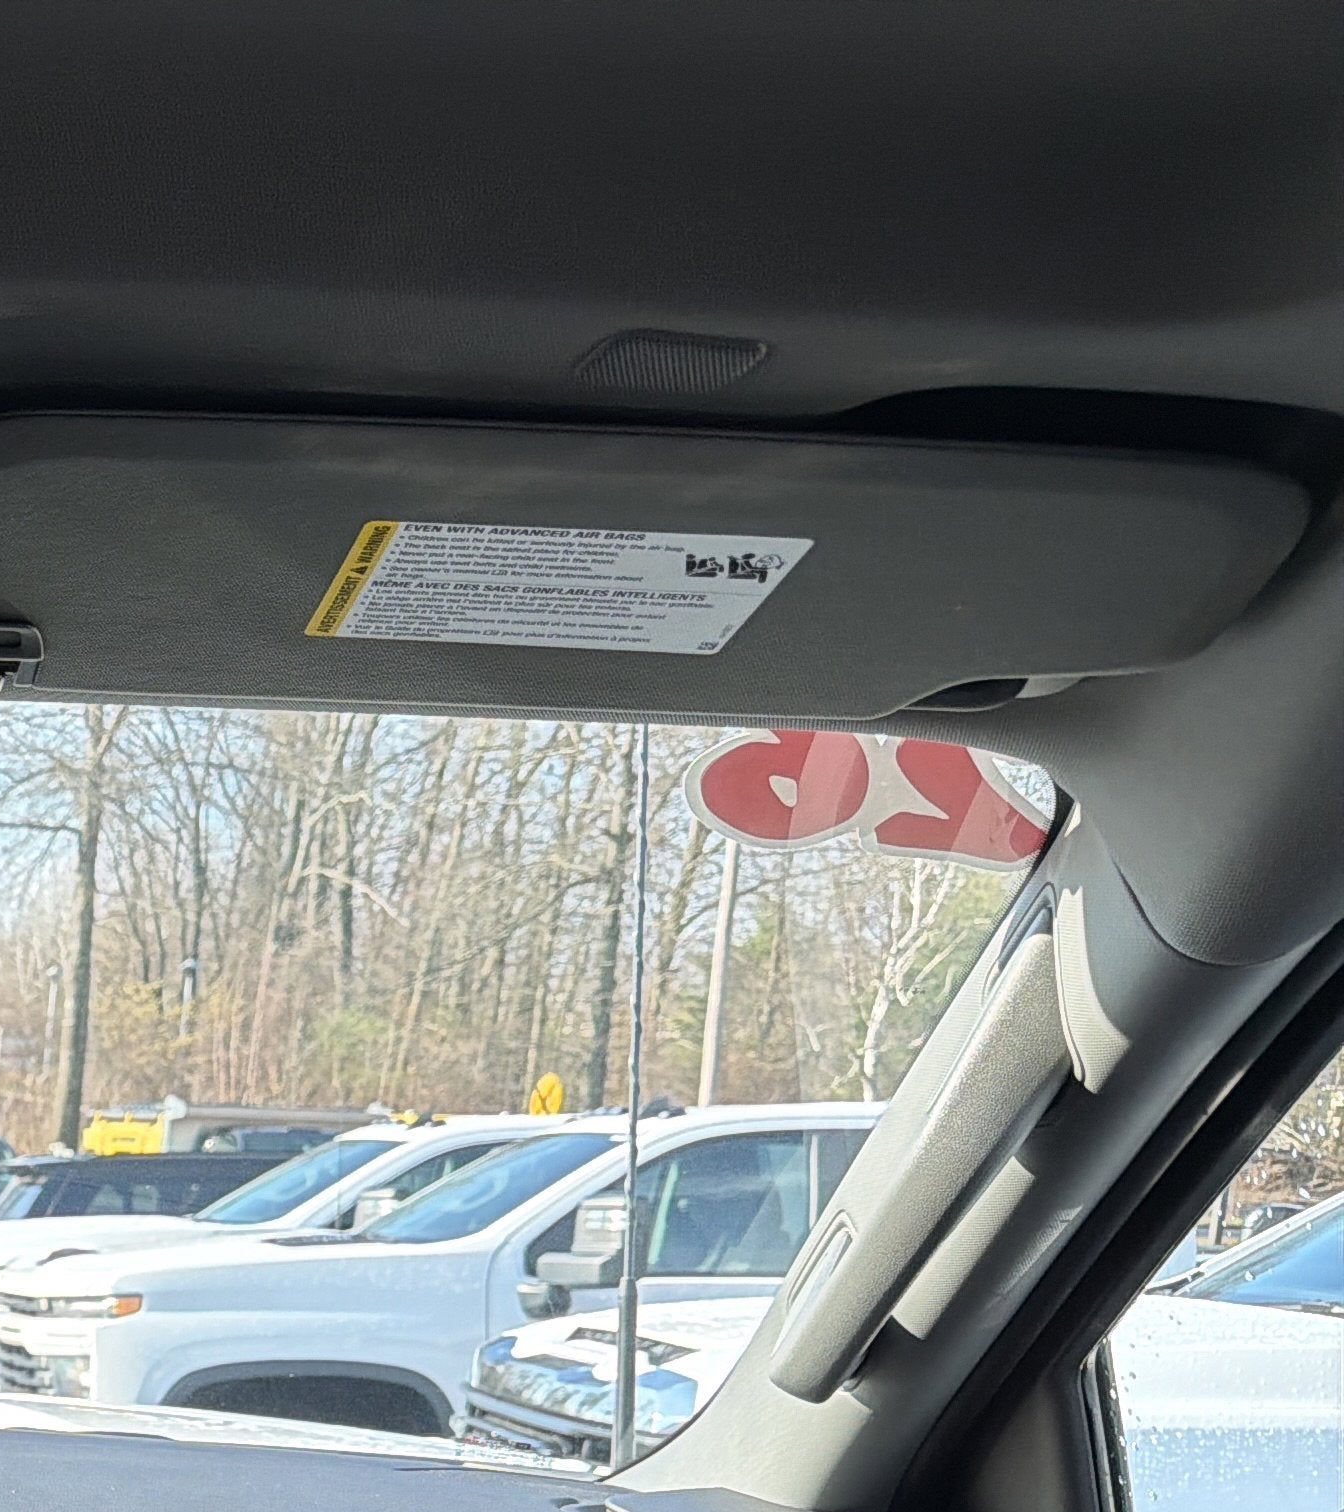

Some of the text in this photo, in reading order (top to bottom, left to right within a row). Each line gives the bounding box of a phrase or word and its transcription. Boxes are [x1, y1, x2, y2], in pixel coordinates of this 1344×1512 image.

[355, 526, 392, 563] WARNING
[403, 524, 646, 541] EVEN WITH ADVANCED AIR BAGS
[316, 575, 363, 634] AVERTISSEMENT
[414, 581, 451, 590] AVEC
[452, 582, 481, 591] DES
[483, 584, 521, 593] SACS
[522, 586, 610, 598] GONFLABLES
[612, 590, 708, 601] INTELLIGENTS
